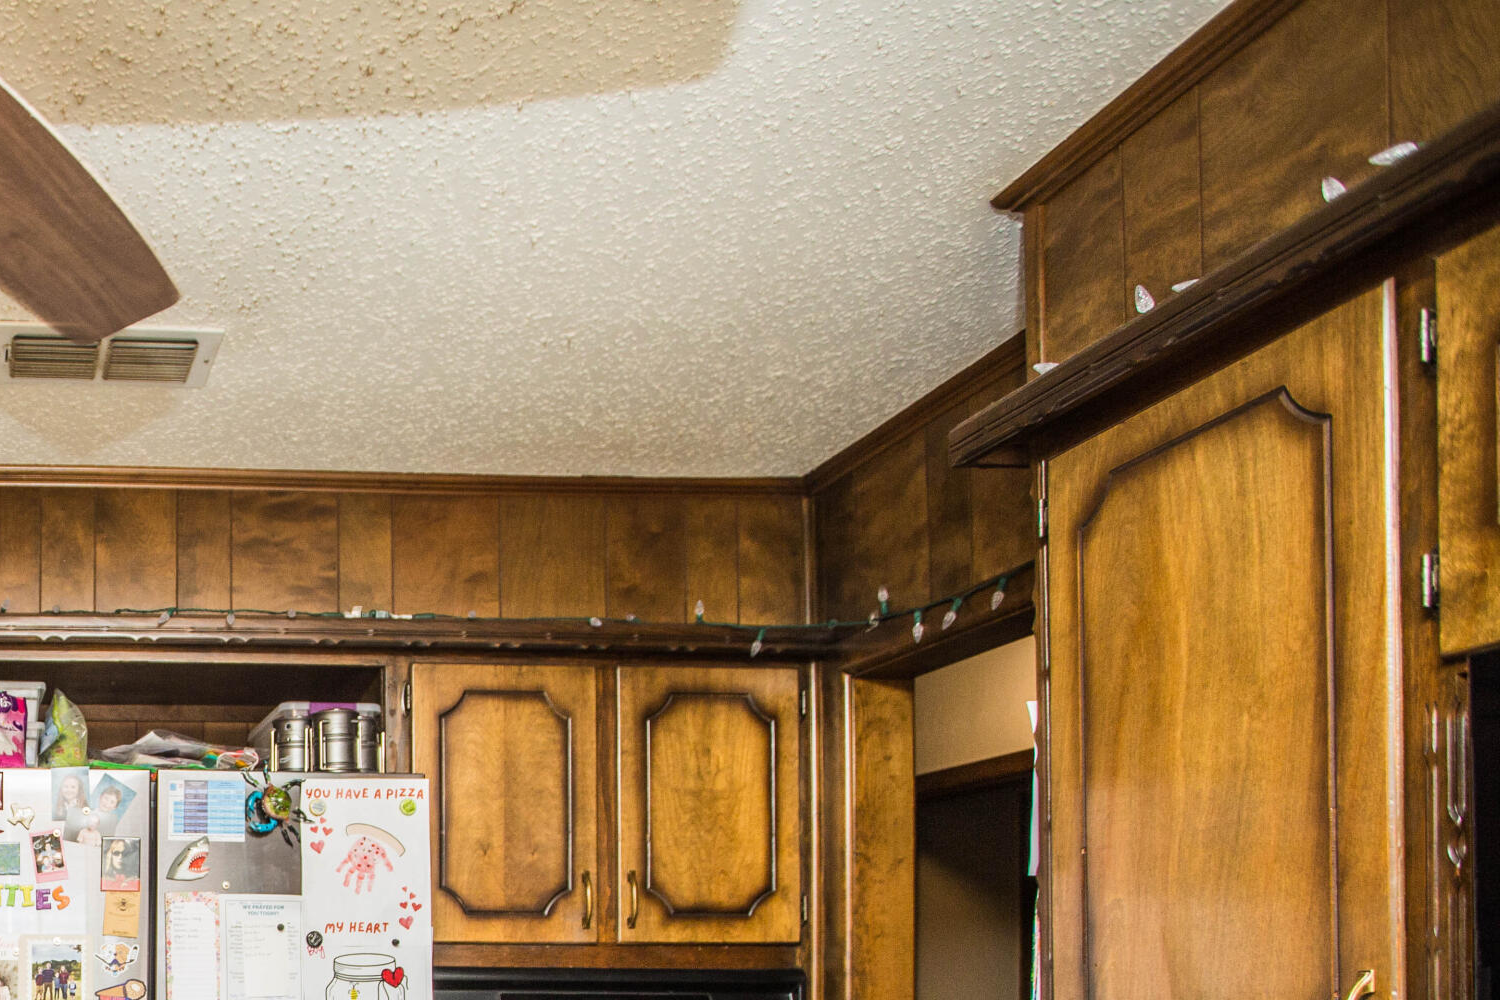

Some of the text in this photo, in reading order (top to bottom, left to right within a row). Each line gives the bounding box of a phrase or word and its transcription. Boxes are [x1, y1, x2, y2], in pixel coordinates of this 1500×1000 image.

[305, 788, 424, 800] YOU HAVE A PIZZA
[324, 921, 390, 934] MY HEART
